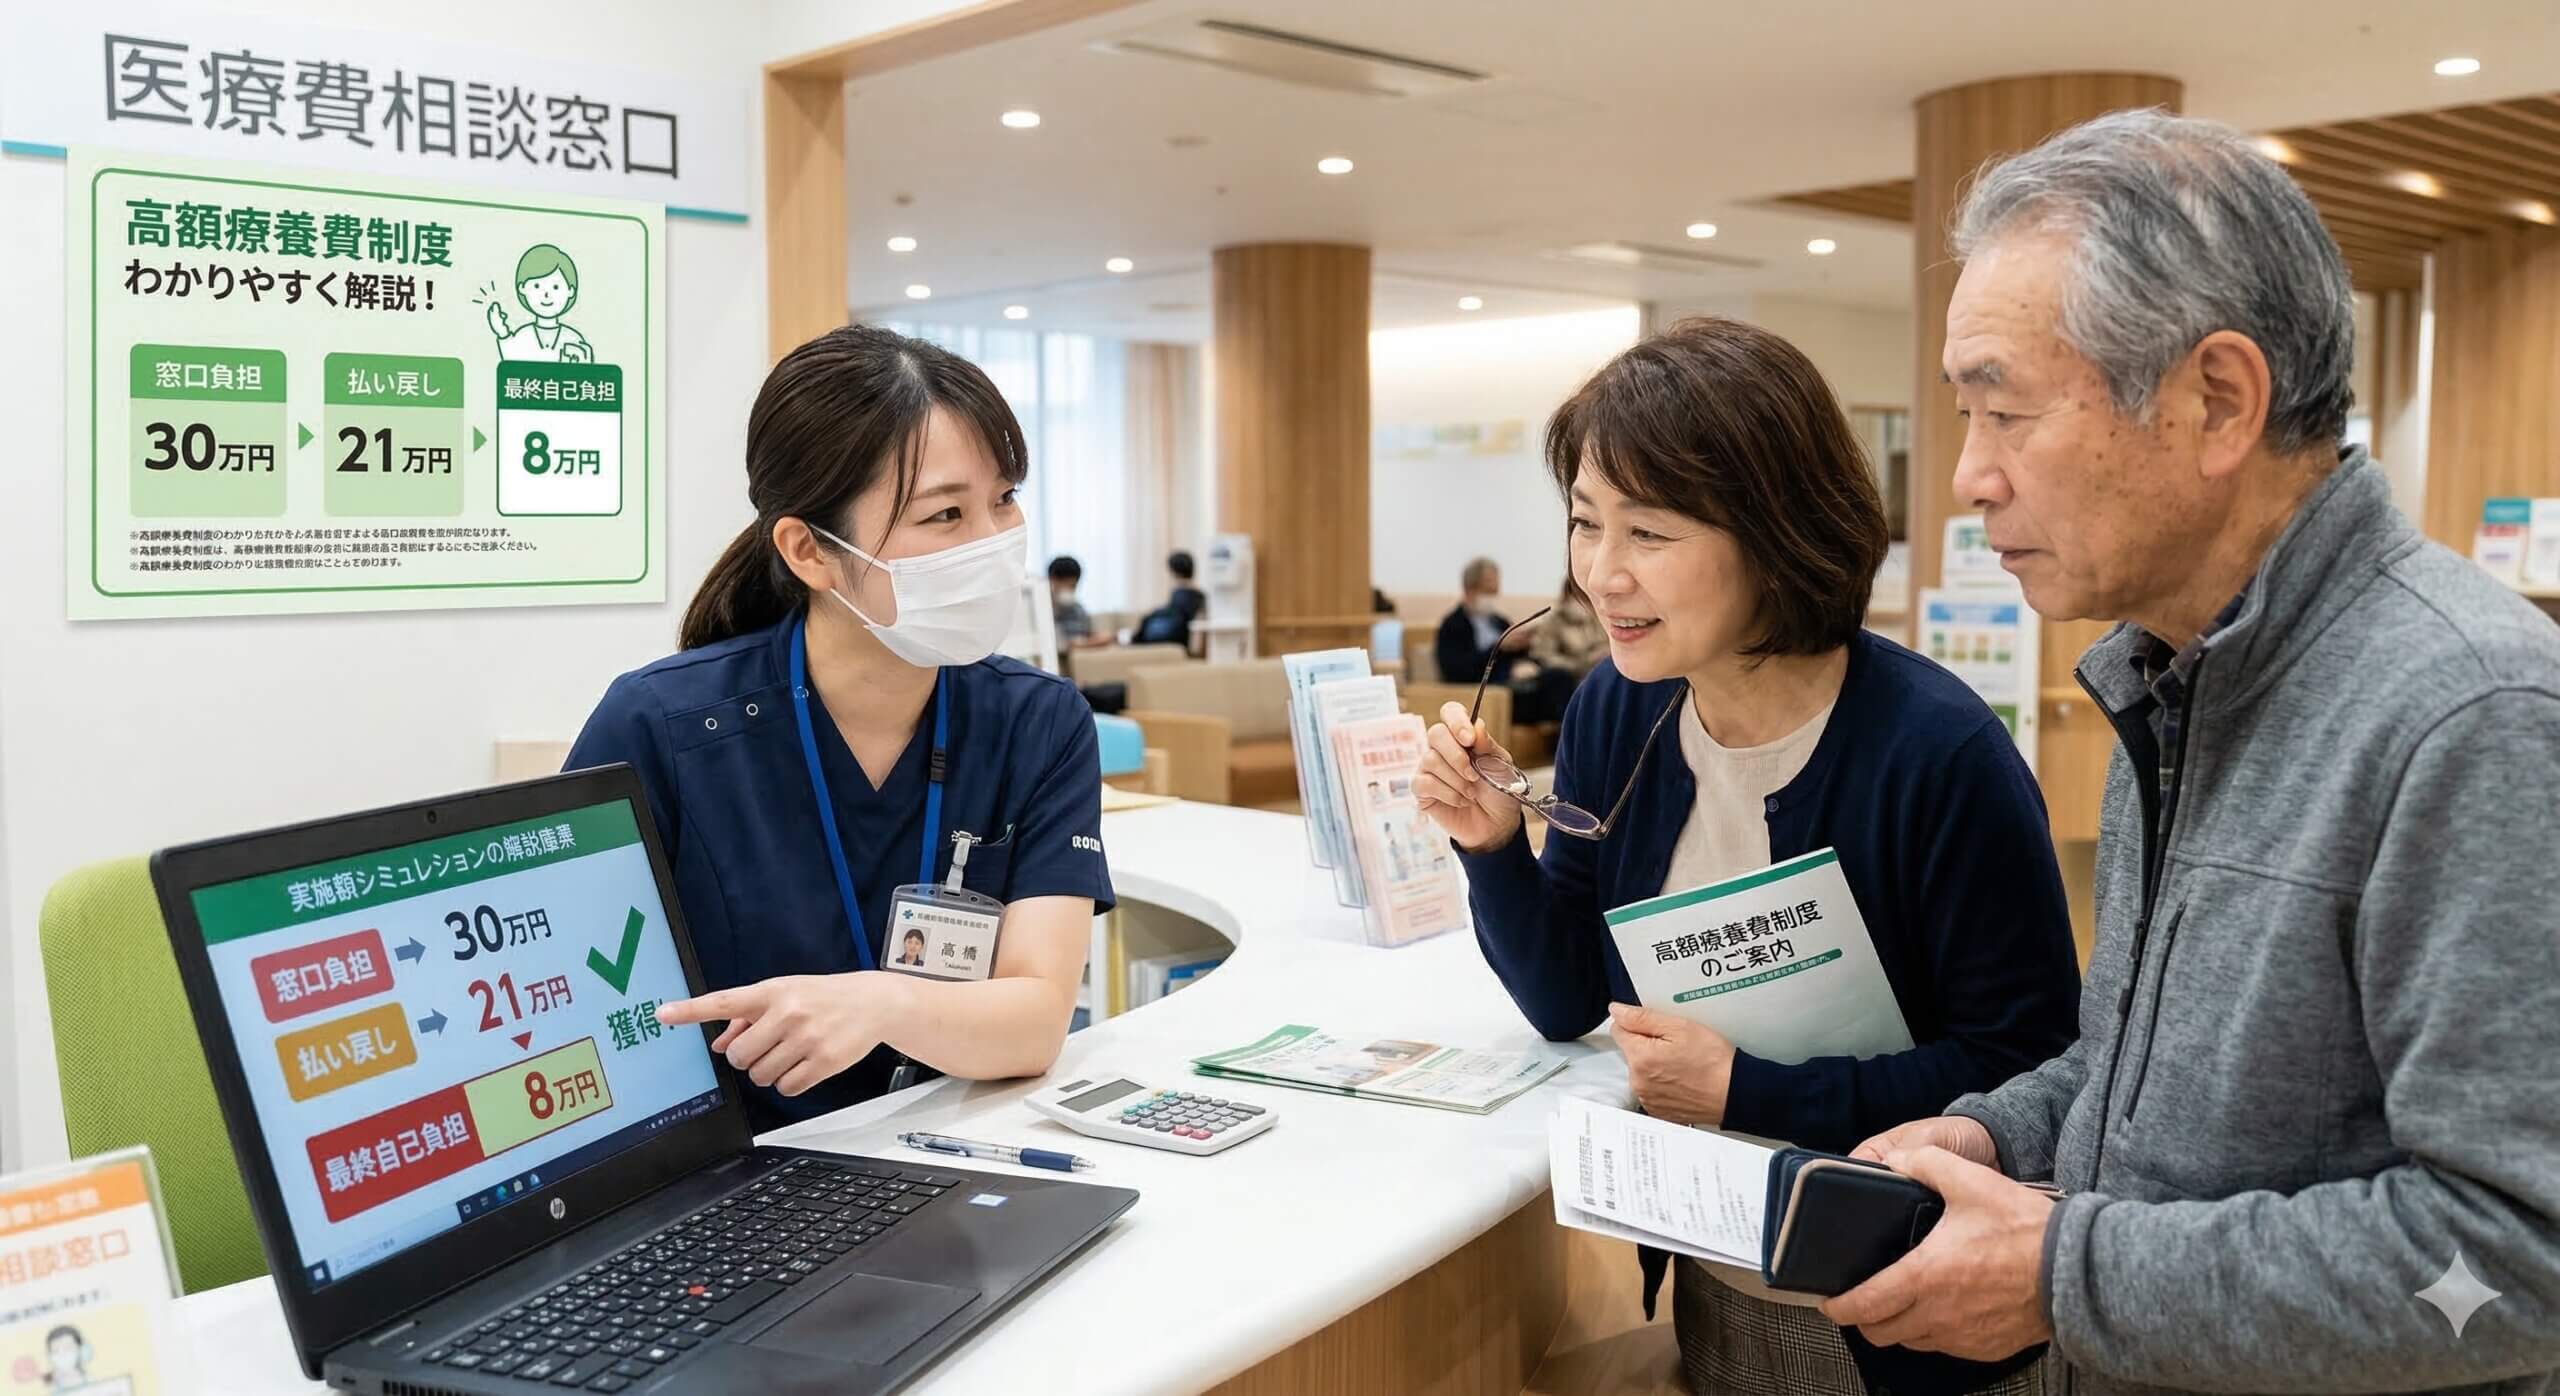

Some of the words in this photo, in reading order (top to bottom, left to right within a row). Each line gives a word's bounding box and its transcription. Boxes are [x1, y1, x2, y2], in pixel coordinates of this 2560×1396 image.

[105, 33, 679, 179] 医療費相談窓口
[126, 198, 453, 268] 高額療養費制度
[124, 259, 434, 312] わかりやすく解説！
[155, 361, 263, 392] 窓口負担
[348, 368, 442, 397] 払い戻し
[504, 377, 617, 402] 最終自己負担
[145, 422, 275, 473] 30万円
[337, 427, 452, 474] 21万円
[522, 431, 601, 475] 8万円
[445, 905, 552, 961] 30万円
[1651, 900, 1823, 964] 高額療養費制度
[1701, 938, 1795, 977] のご案内
[271, 949, 377, 1003] 窓口負担
[468, 973, 573, 1033] 21万円
[297, 1030, 397, 1083] 払い戻し
[525, 1069, 600, 1120] 8万円
[325, 1112, 470, 1193] 最終自己負担
